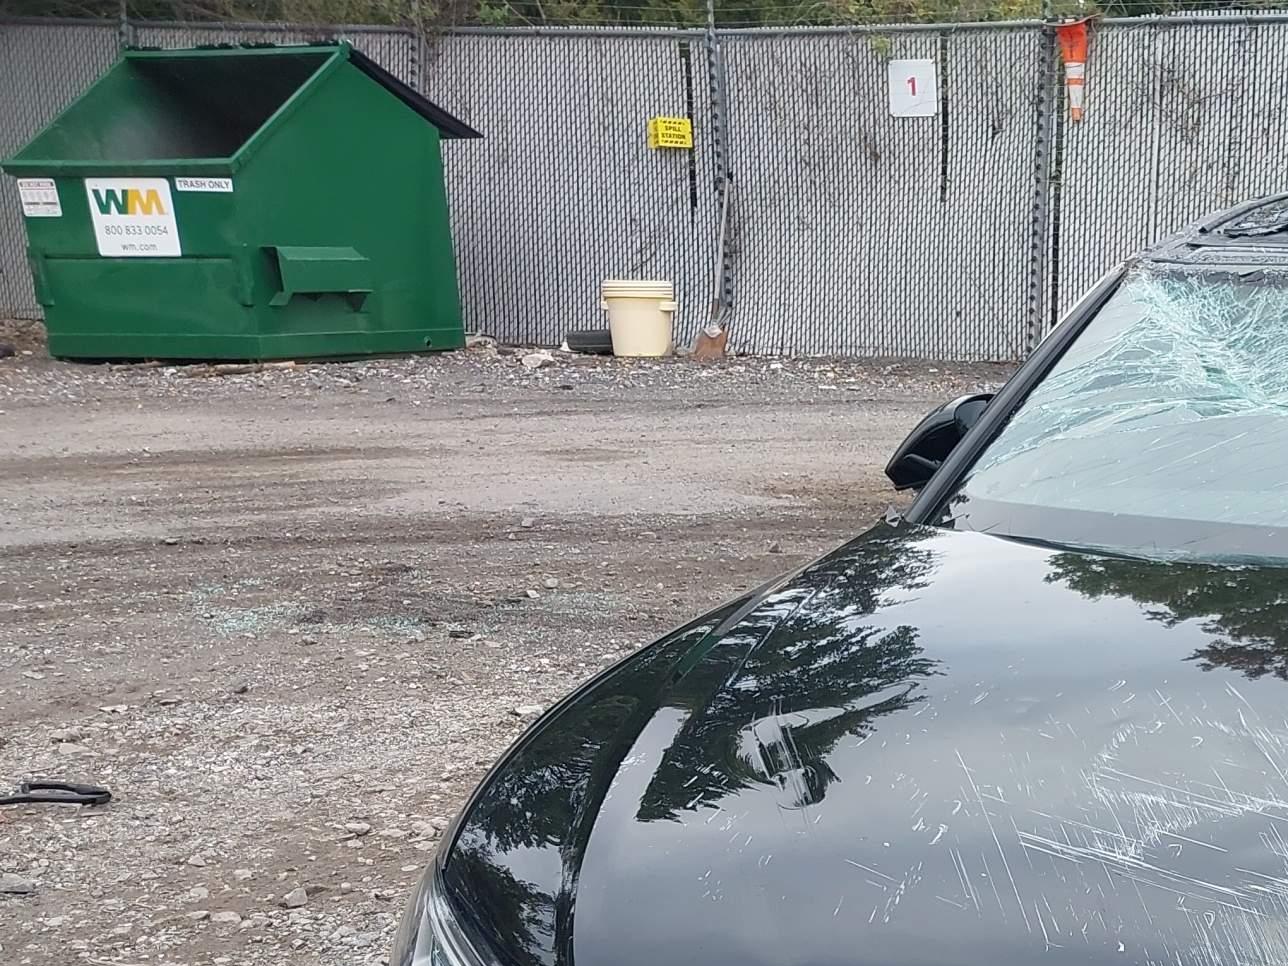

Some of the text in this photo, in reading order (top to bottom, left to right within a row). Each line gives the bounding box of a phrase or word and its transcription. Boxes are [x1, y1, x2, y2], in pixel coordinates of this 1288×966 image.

[907, 76, 916, 97] 1
[178, 180, 230, 189] TRASH ONLY
[91, 188, 166, 215] WM
[105, 225, 169, 235] 800 833 0054
[121, 243, 158, 251] wm.com
